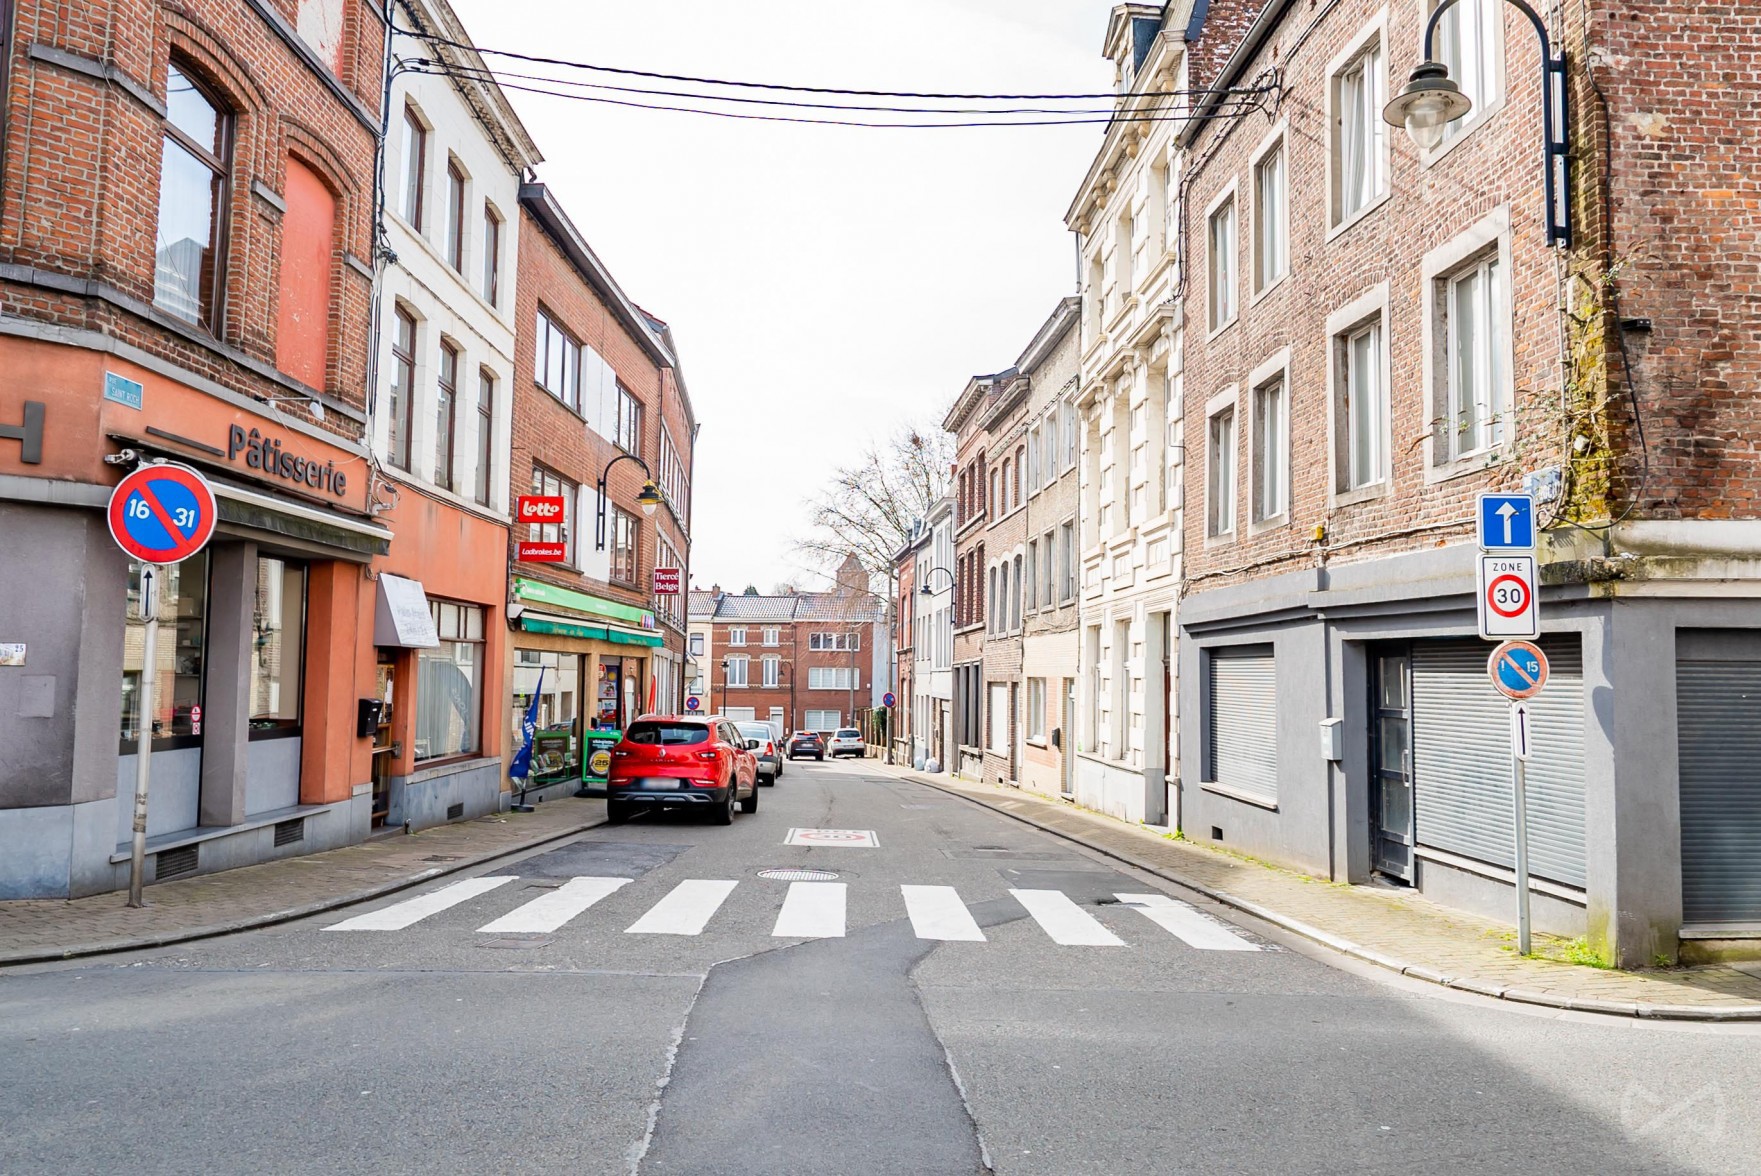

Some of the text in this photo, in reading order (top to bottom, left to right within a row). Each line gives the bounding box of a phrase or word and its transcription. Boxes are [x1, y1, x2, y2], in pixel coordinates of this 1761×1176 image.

[111, 386, 140, 405] SAINT ROCH
[229, 423, 346, 496] Pâtisserie
[129, 498, 150, 519] 16
[172, 507, 195, 528] 31
[1493, 562, 1523, 572] ZONE
[655, 572, 679, 580] Tiercé
[655, 582, 679, 591] Belge
[1497, 588, 1521, 604] 30
[1500, 660, 1505, 671] 1
[1526, 661, 1538, 672] 15
